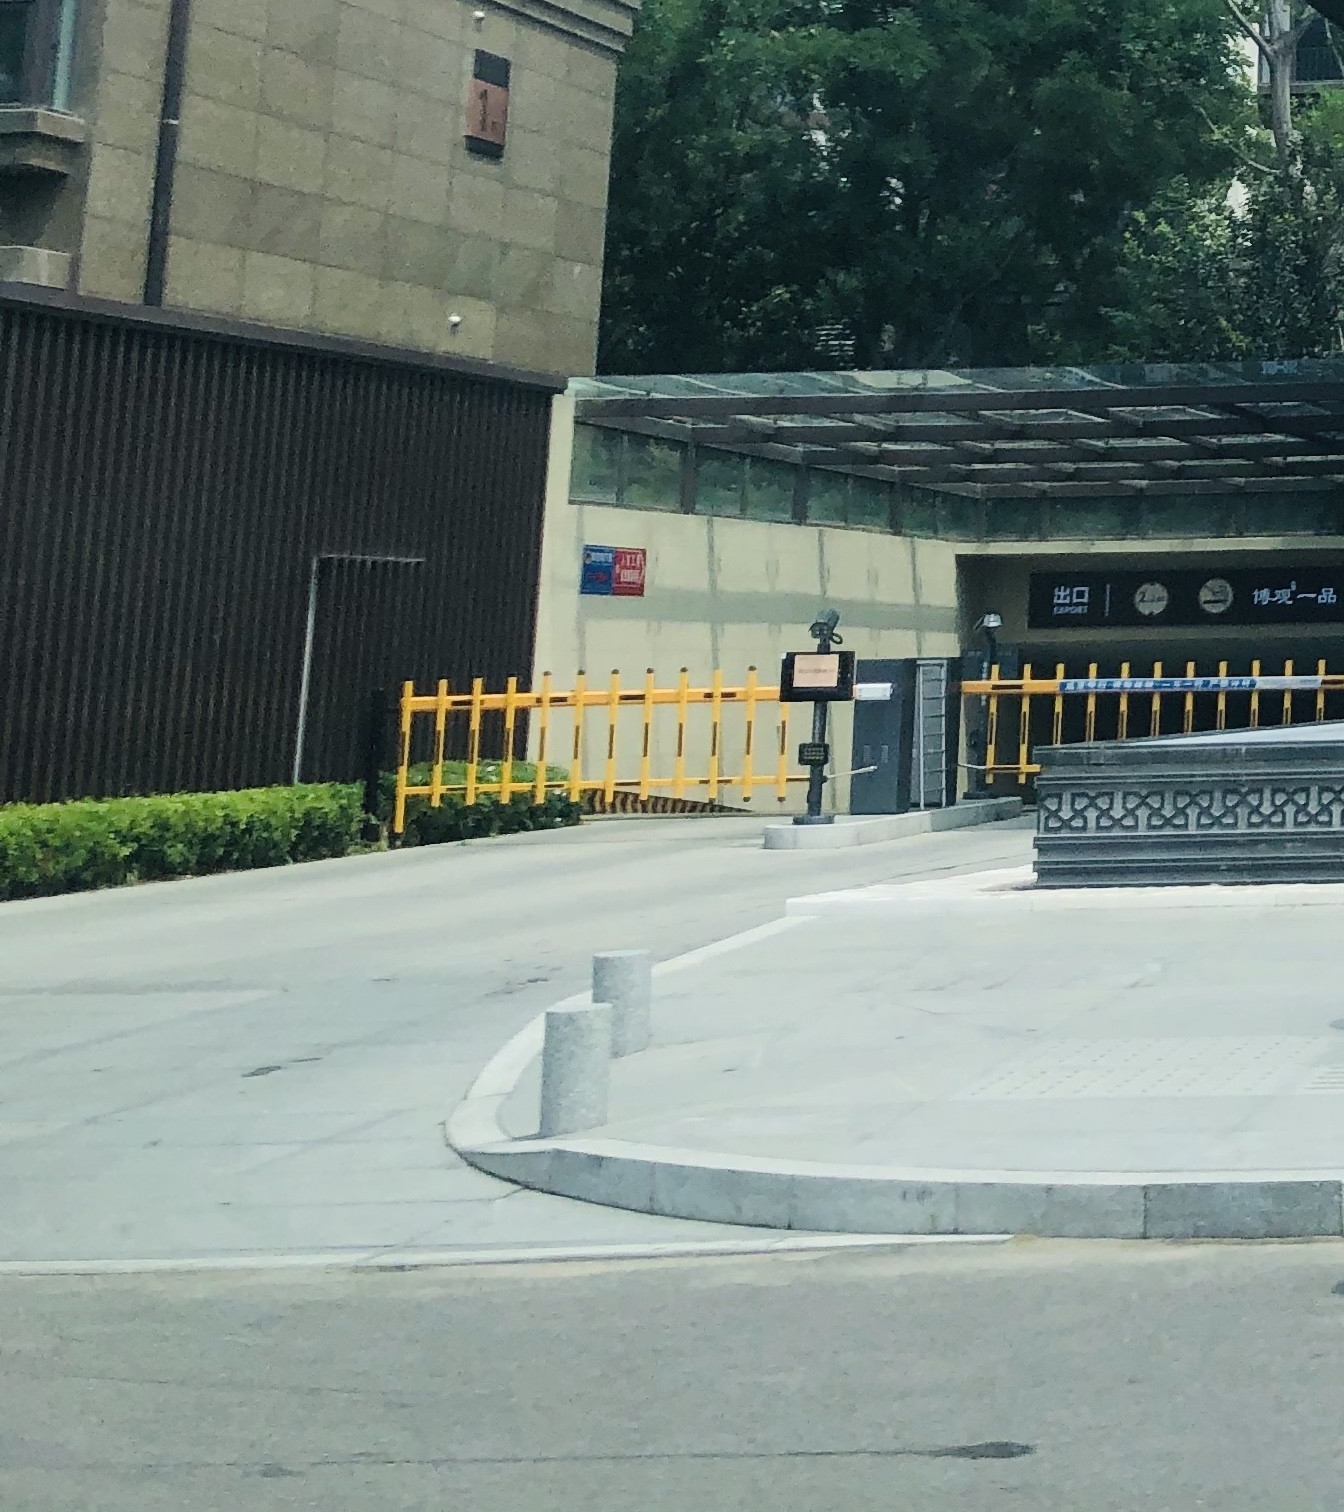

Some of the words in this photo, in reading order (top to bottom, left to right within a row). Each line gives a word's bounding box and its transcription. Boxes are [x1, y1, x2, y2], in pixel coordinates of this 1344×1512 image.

[1053, 585, 1090, 605] 出口
[1252, 586, 1337, 605] 博观一品
